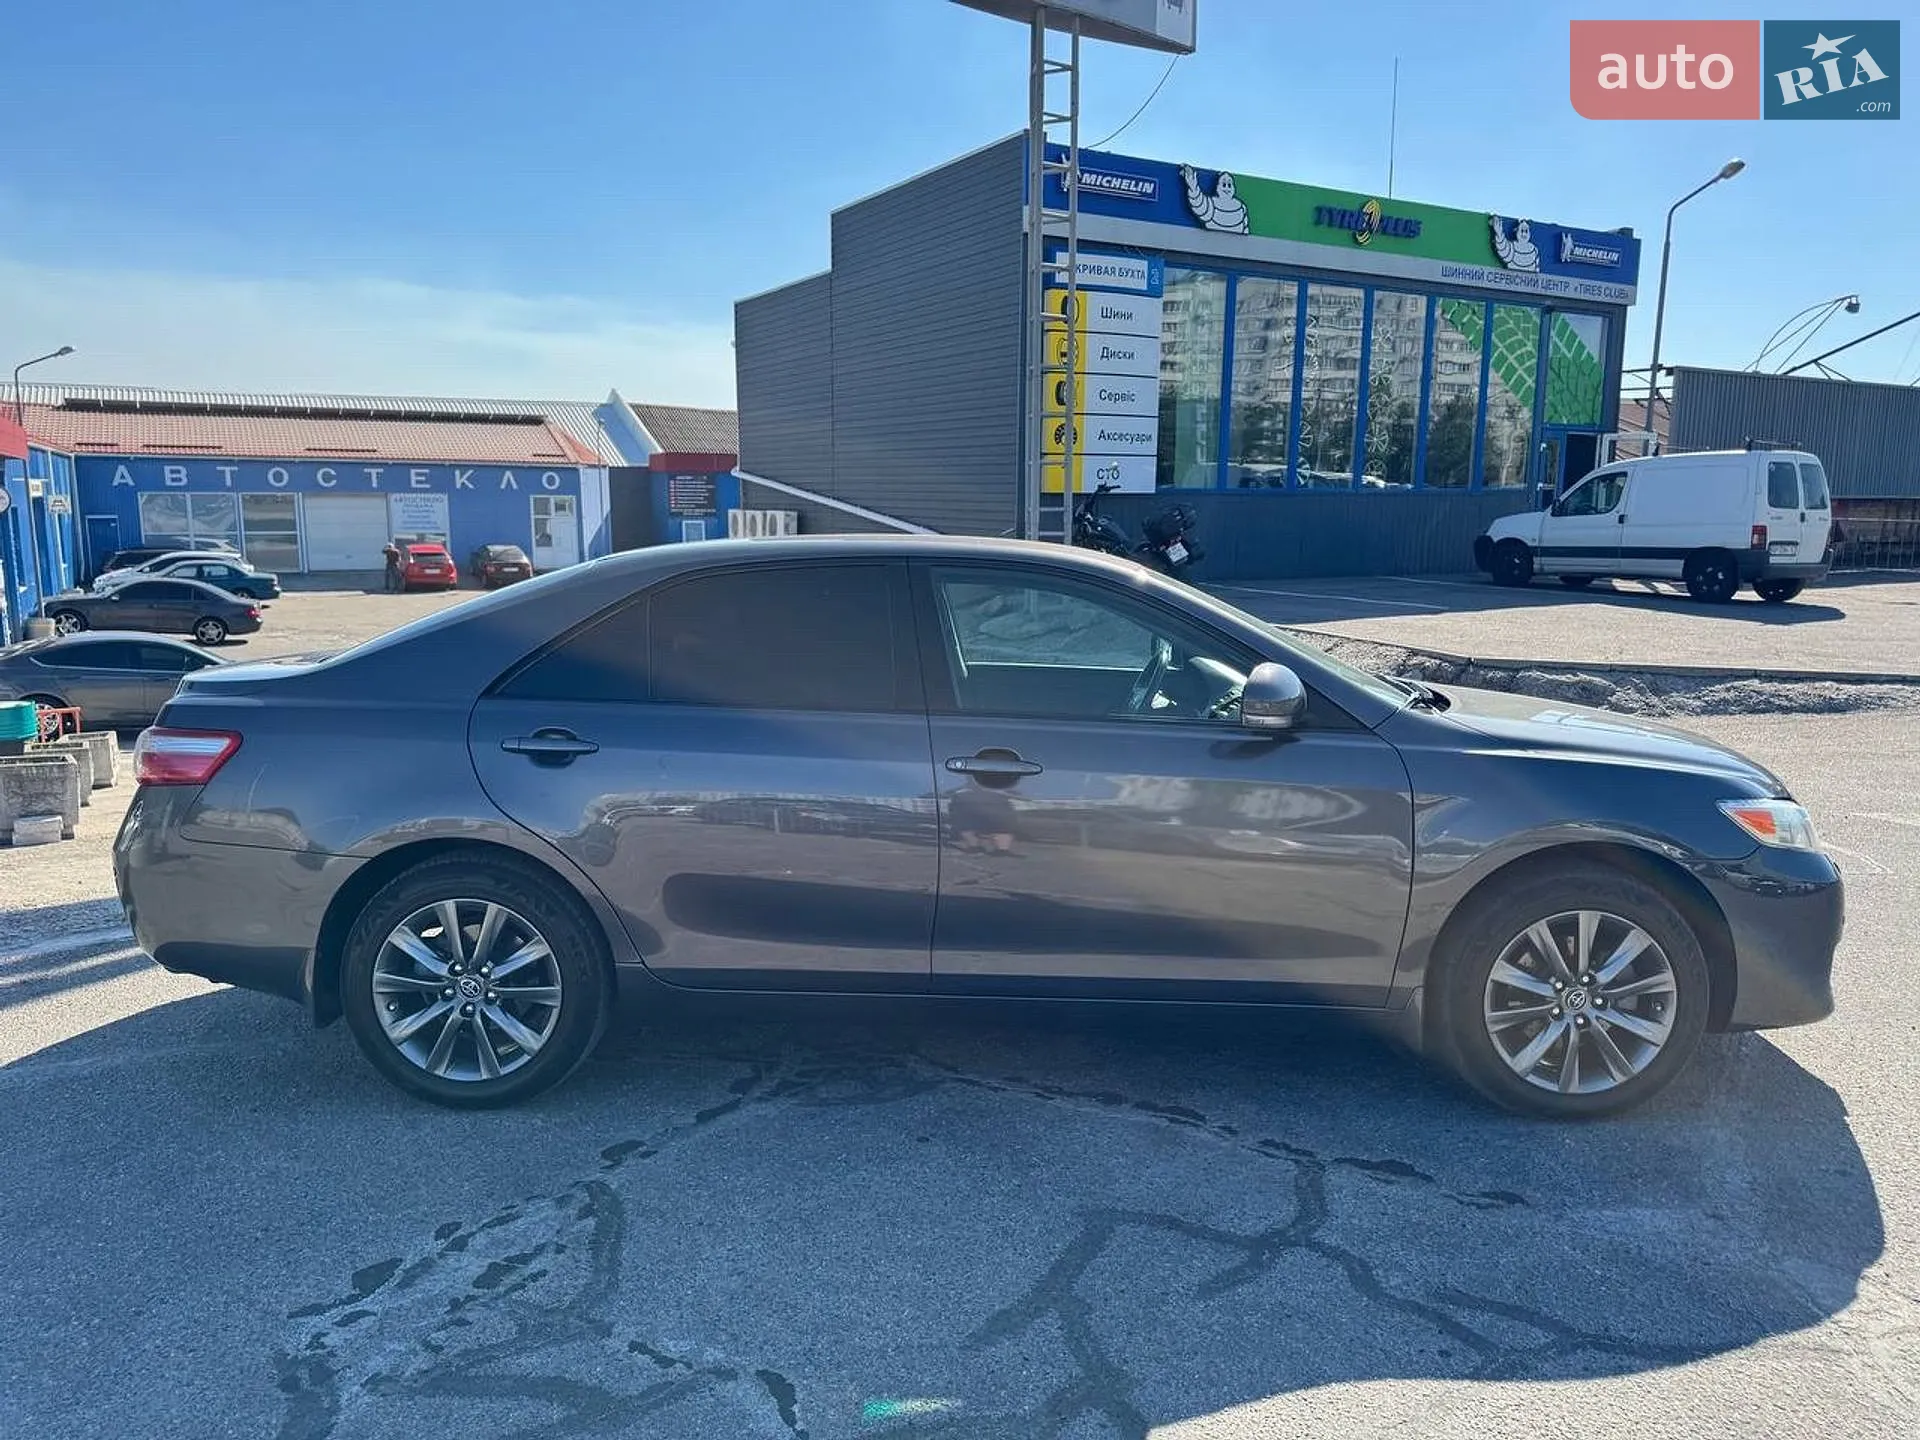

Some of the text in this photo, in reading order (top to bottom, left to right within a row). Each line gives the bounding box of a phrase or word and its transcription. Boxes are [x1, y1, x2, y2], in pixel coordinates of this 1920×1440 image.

[1081, 172, 1155, 195] MICHELIN
[1573, 246, 1620, 262] MICHELIN
[1118, 266, 1146, 280] БУХТА
[1441, 265, 1485, 281] ШИННИЙ
[1540, 277, 1571, 293] ЦЕНТР
[1100, 305, 1135, 321] Шини
[1100, 346, 1136, 361] Диски
[1099, 388, 1137, 404] Сервіс
[1097, 429, 1154, 445] Аксесуари
[112, 464, 561, 490] АВТОСТЕКЛО
[1096, 467, 1121, 480] СТО
